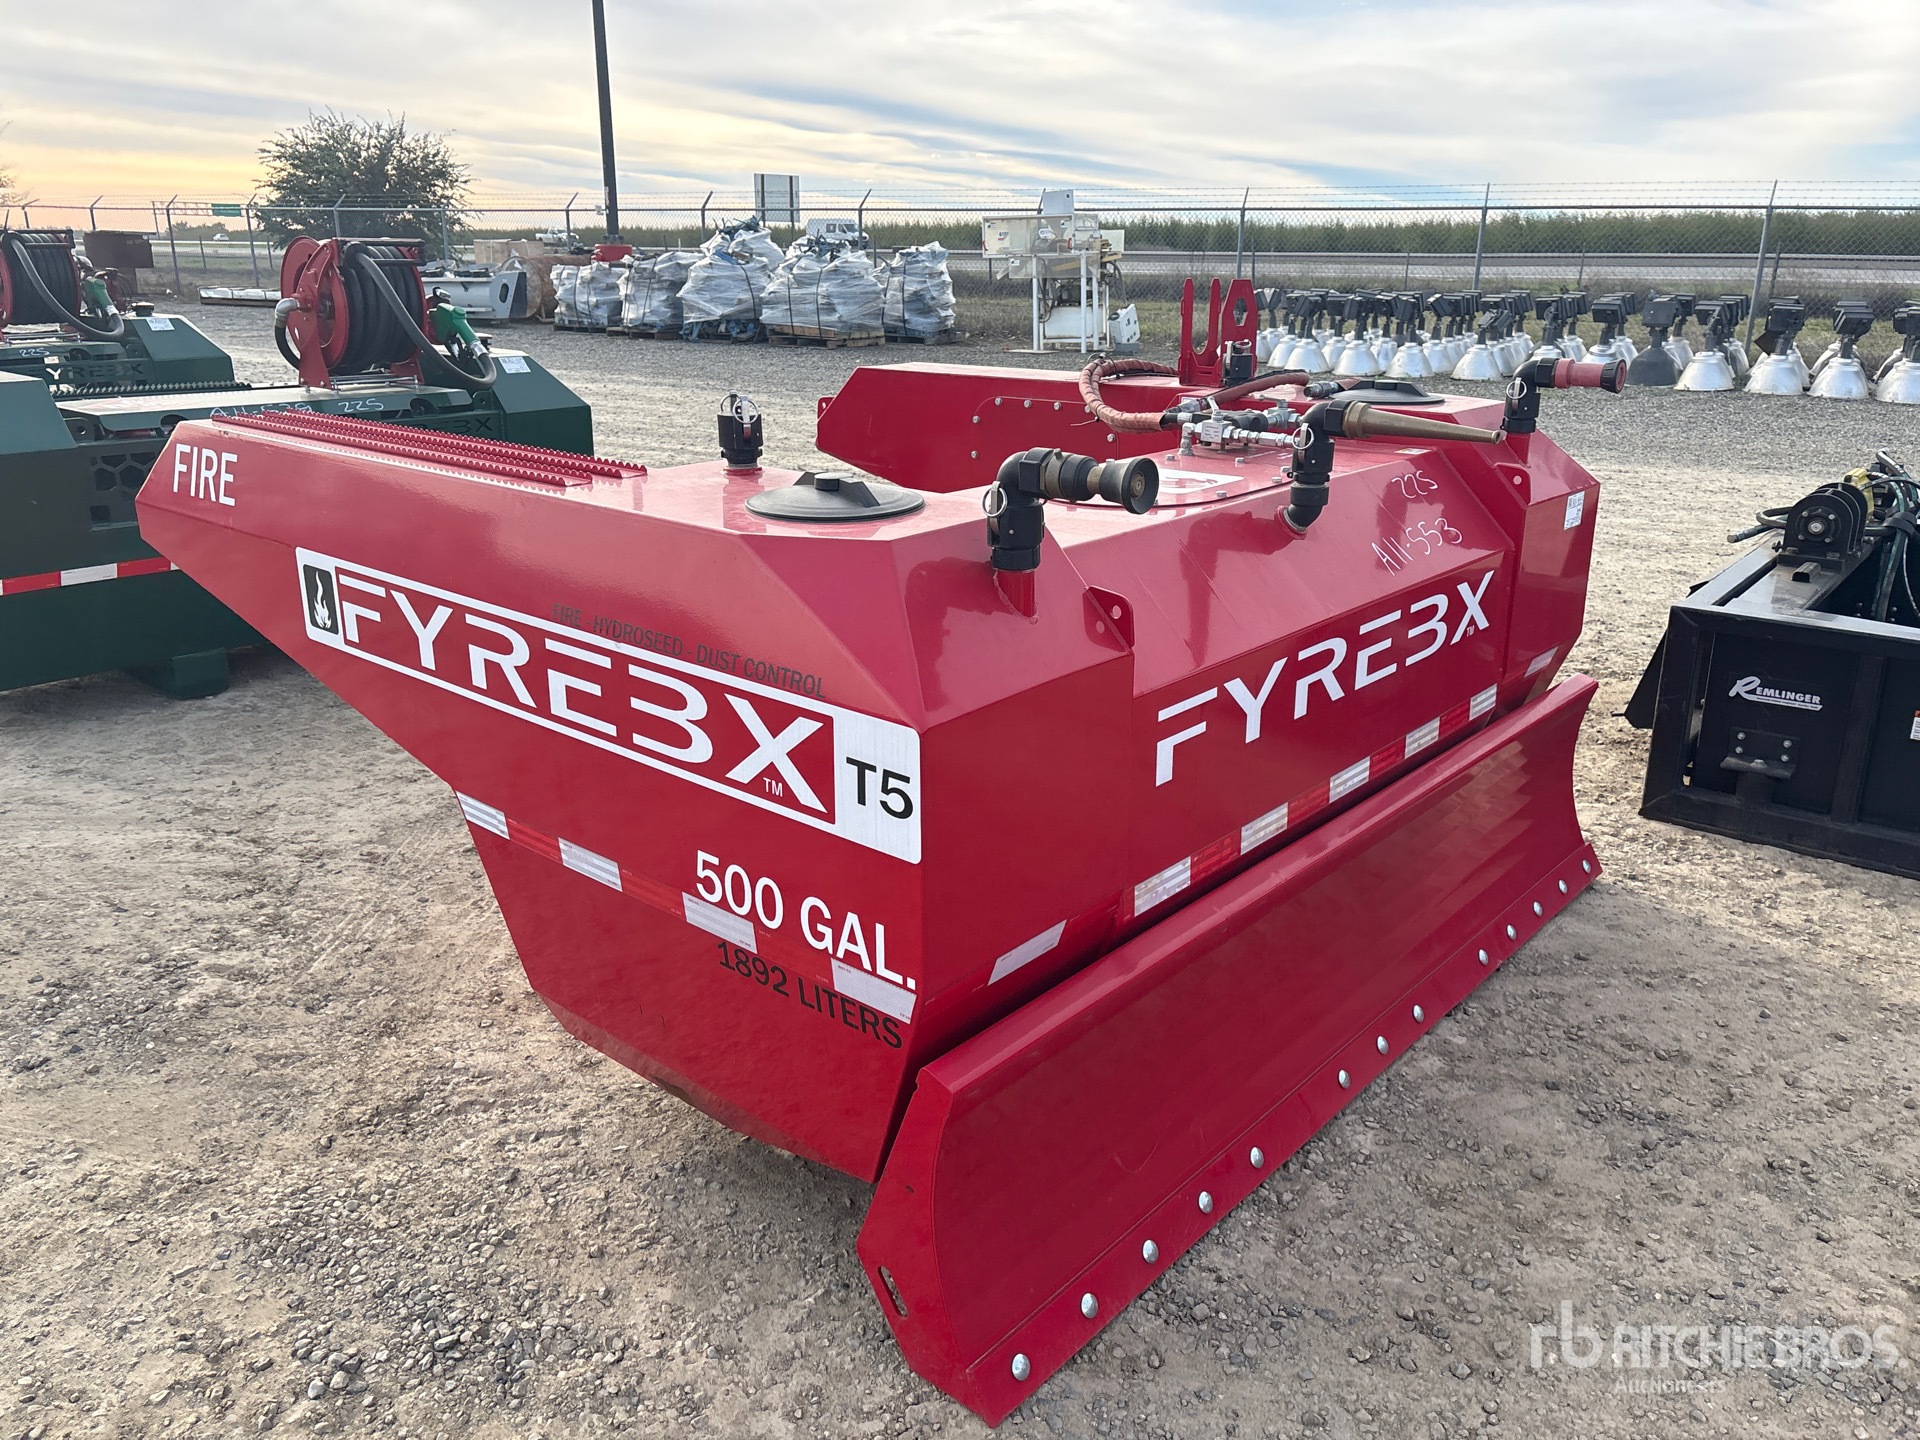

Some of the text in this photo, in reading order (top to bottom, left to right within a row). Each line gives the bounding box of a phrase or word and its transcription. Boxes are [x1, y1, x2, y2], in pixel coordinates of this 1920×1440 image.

[173, 443, 238, 507] FIRE
[552, 603, 583, 629] FIRE
[593, 615, 684, 658] HYDROSEED
[696, 643, 740, 675] DUST
[743, 657, 826, 700] CONTROL
[1728, 675, 1822, 706] REMLINGER
[846, 756, 914, 820] T5
[696, 850, 917, 991] 500 GAL.
[717, 941, 903, 1049] 1892 LITERS
